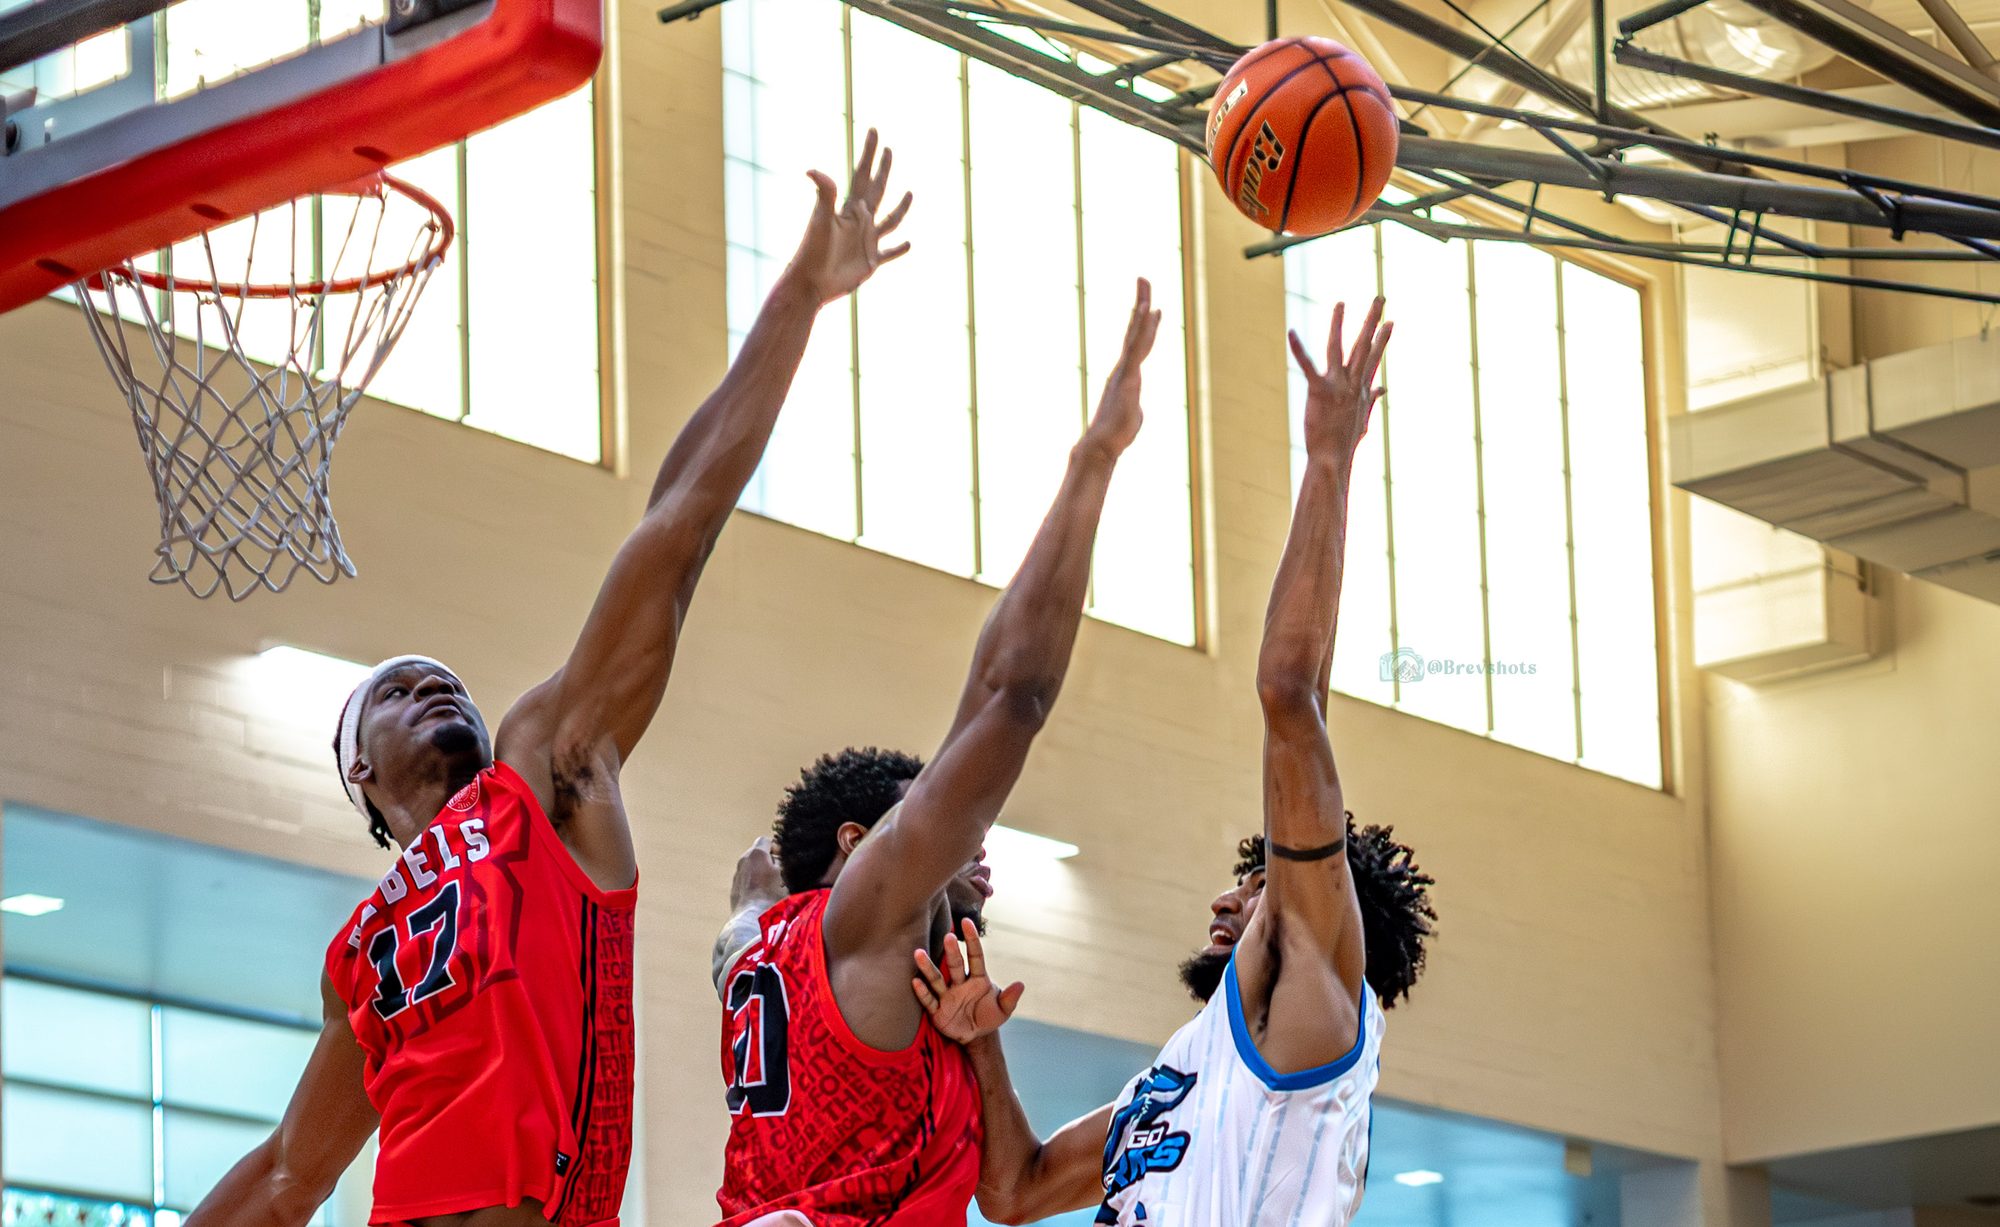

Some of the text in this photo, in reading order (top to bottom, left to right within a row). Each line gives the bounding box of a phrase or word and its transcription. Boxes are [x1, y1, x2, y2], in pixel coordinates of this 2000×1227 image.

[1240, 120, 1286, 217] Bad
[347, 818, 490, 949] BELS
[367, 879, 461, 1021] 17
